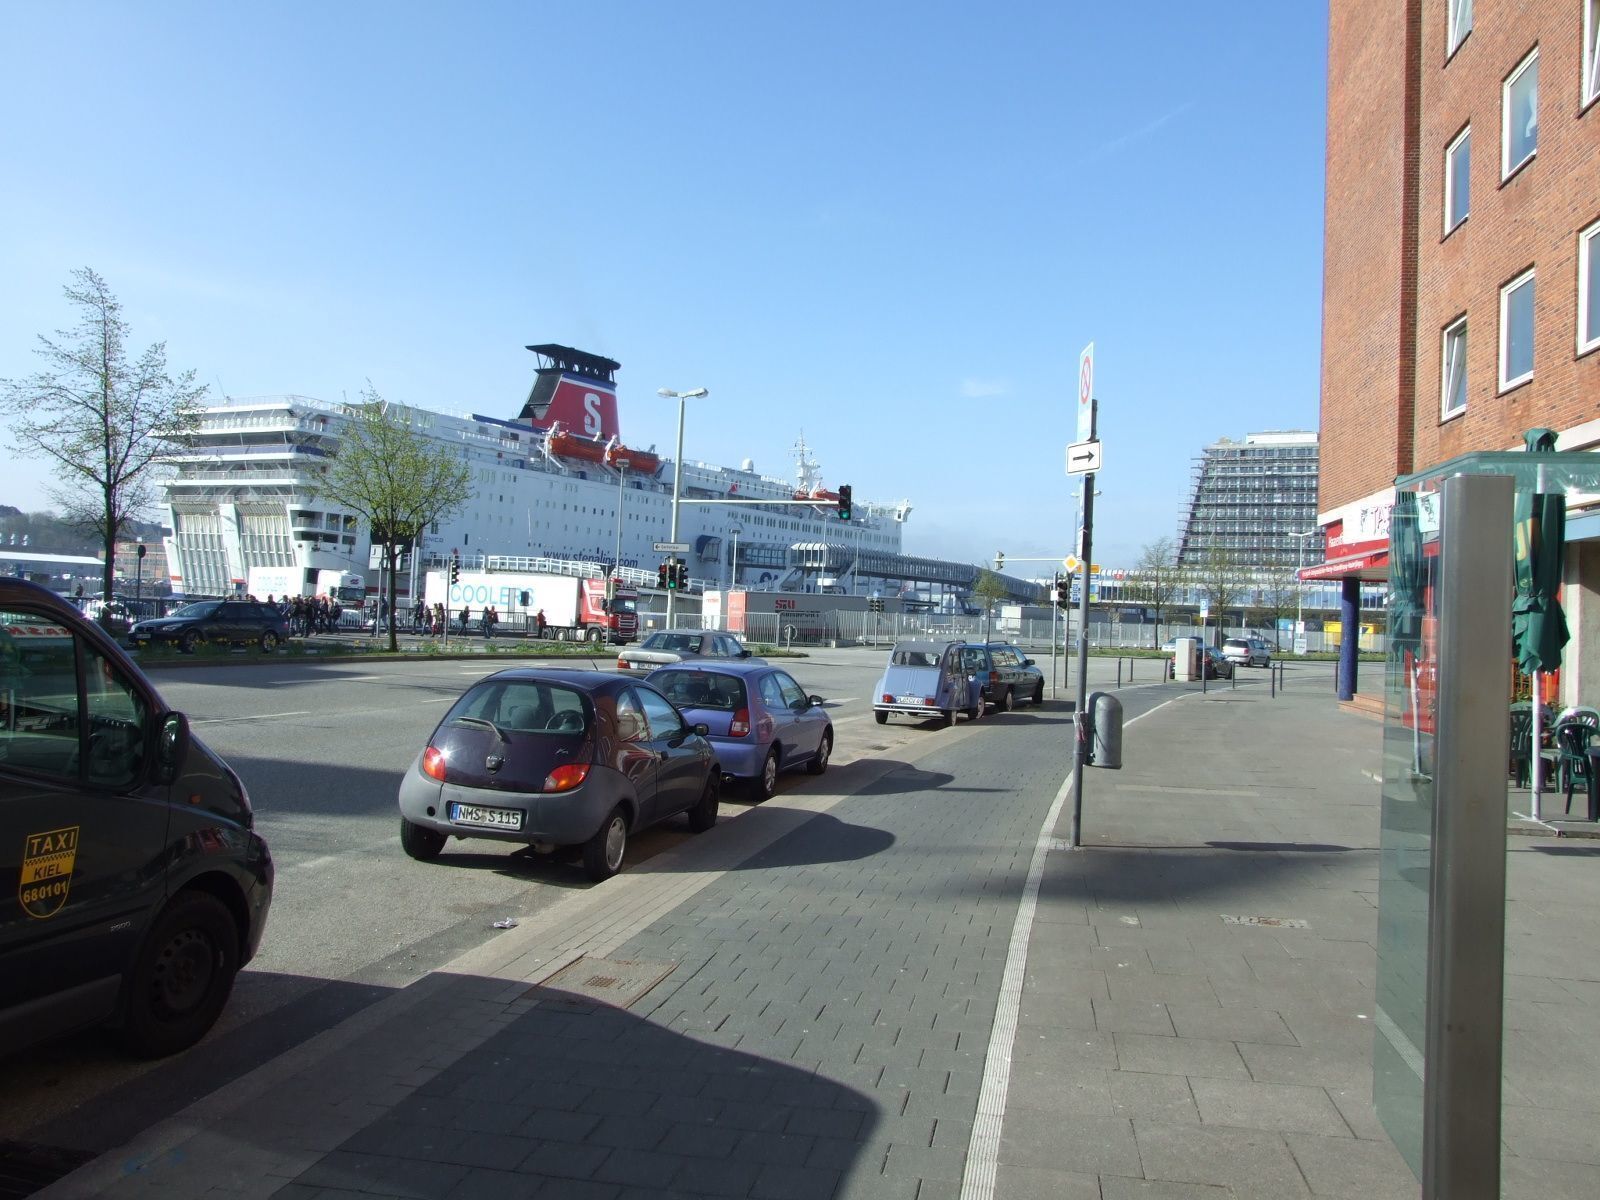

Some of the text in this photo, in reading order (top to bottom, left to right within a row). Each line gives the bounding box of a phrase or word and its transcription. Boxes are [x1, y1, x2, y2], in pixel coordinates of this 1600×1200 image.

[584, 392, 602, 436] S
[458, 806, 481, 821] NMS
[497, 812, 520, 825] 115
[31, 832, 75, 855] TAXI
[33, 863, 62, 881] KIEL
[23, 881, 68, 903] 680101
